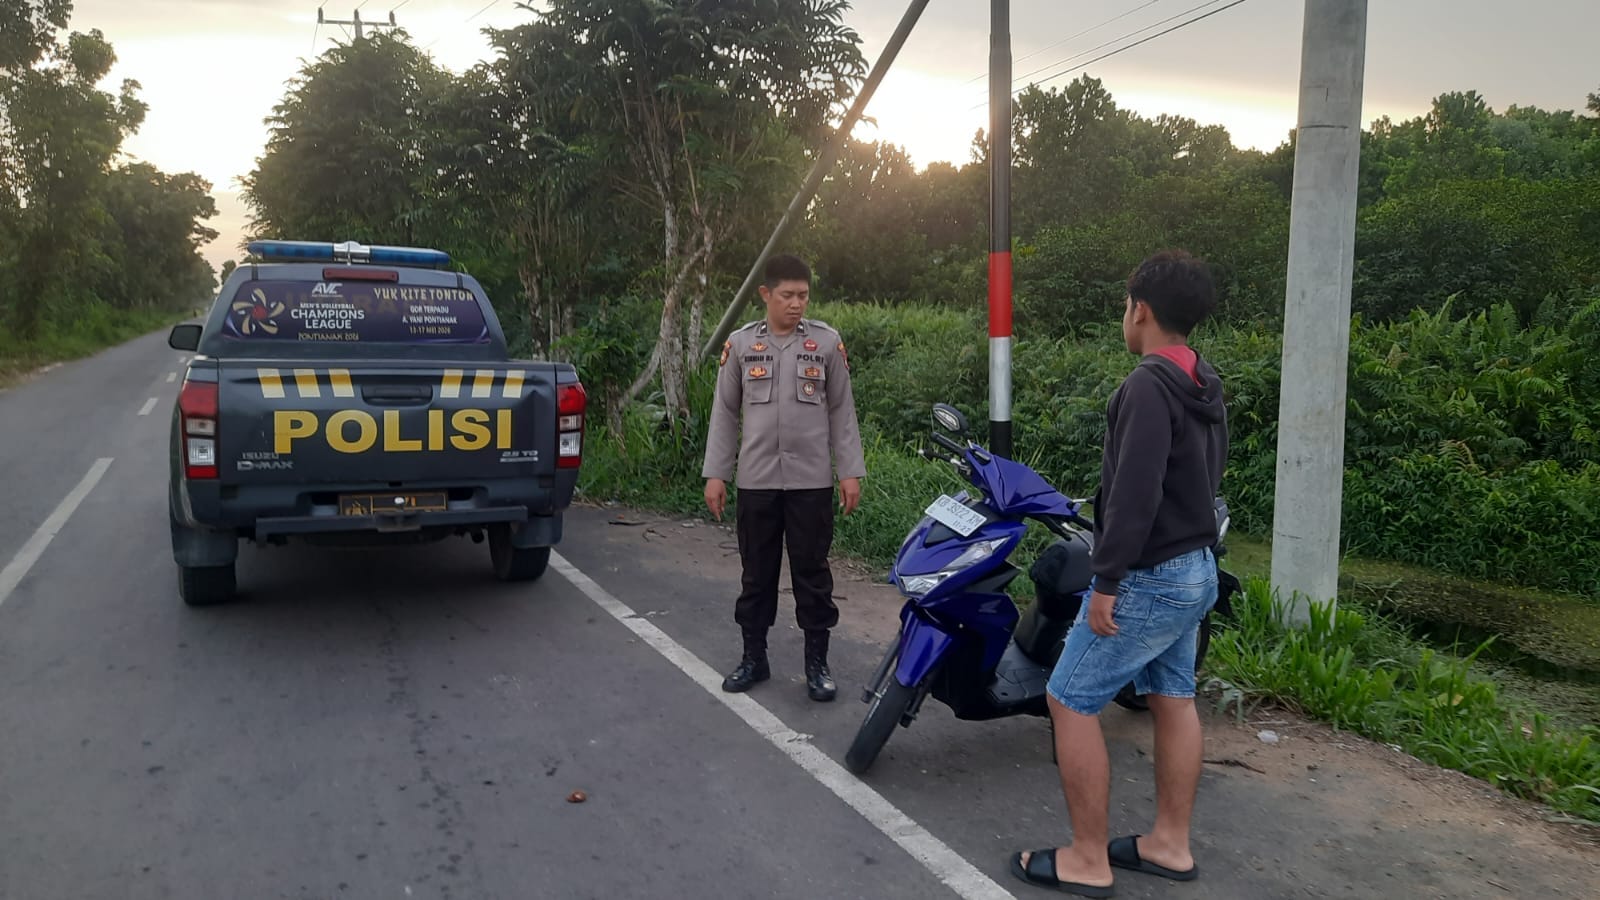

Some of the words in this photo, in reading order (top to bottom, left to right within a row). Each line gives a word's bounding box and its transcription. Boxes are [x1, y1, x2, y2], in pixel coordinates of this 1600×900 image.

[312, 282, 342, 294] AVC
[374, 287, 398, 300] YUK
[400, 287, 427, 301] KITE
[429, 289, 473, 301] TONTON
[291, 309, 365, 320] CHAMPIONS
[410, 305, 423, 313] GOR
[424, 305, 449, 314] TERPADU
[305, 319, 352, 329] LEAGUE
[424, 316, 457, 324] PONTIANAK
[797, 354, 824, 363] POLRI
[273, 409, 512, 454] POLISI
[237, 460, 294, 471] D-MAX
